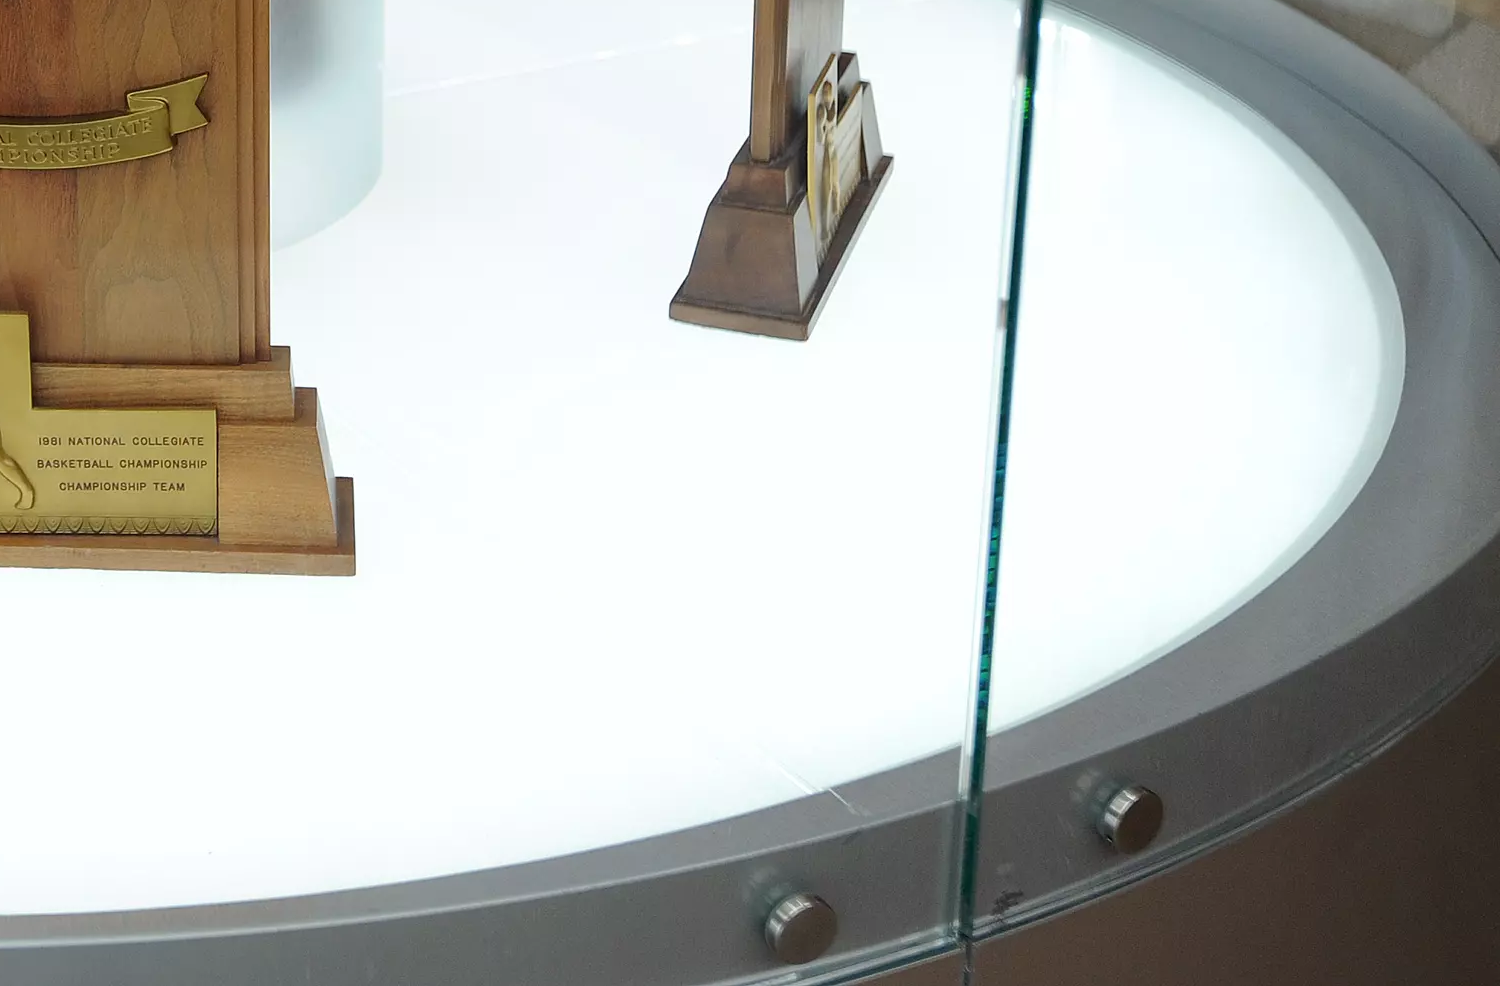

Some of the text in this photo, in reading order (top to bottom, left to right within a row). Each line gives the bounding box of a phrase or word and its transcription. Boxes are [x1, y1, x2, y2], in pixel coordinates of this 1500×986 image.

[27, 116, 153, 147] COLLEGIATE
[37, 436, 205, 447] 1981 NATIONAL COLLEGIATE
[36, 459, 208, 470] BASKETBALL CHAMPIONSHIP
[59, 482, 186, 492] CHAMPIONSHIP TEAM
